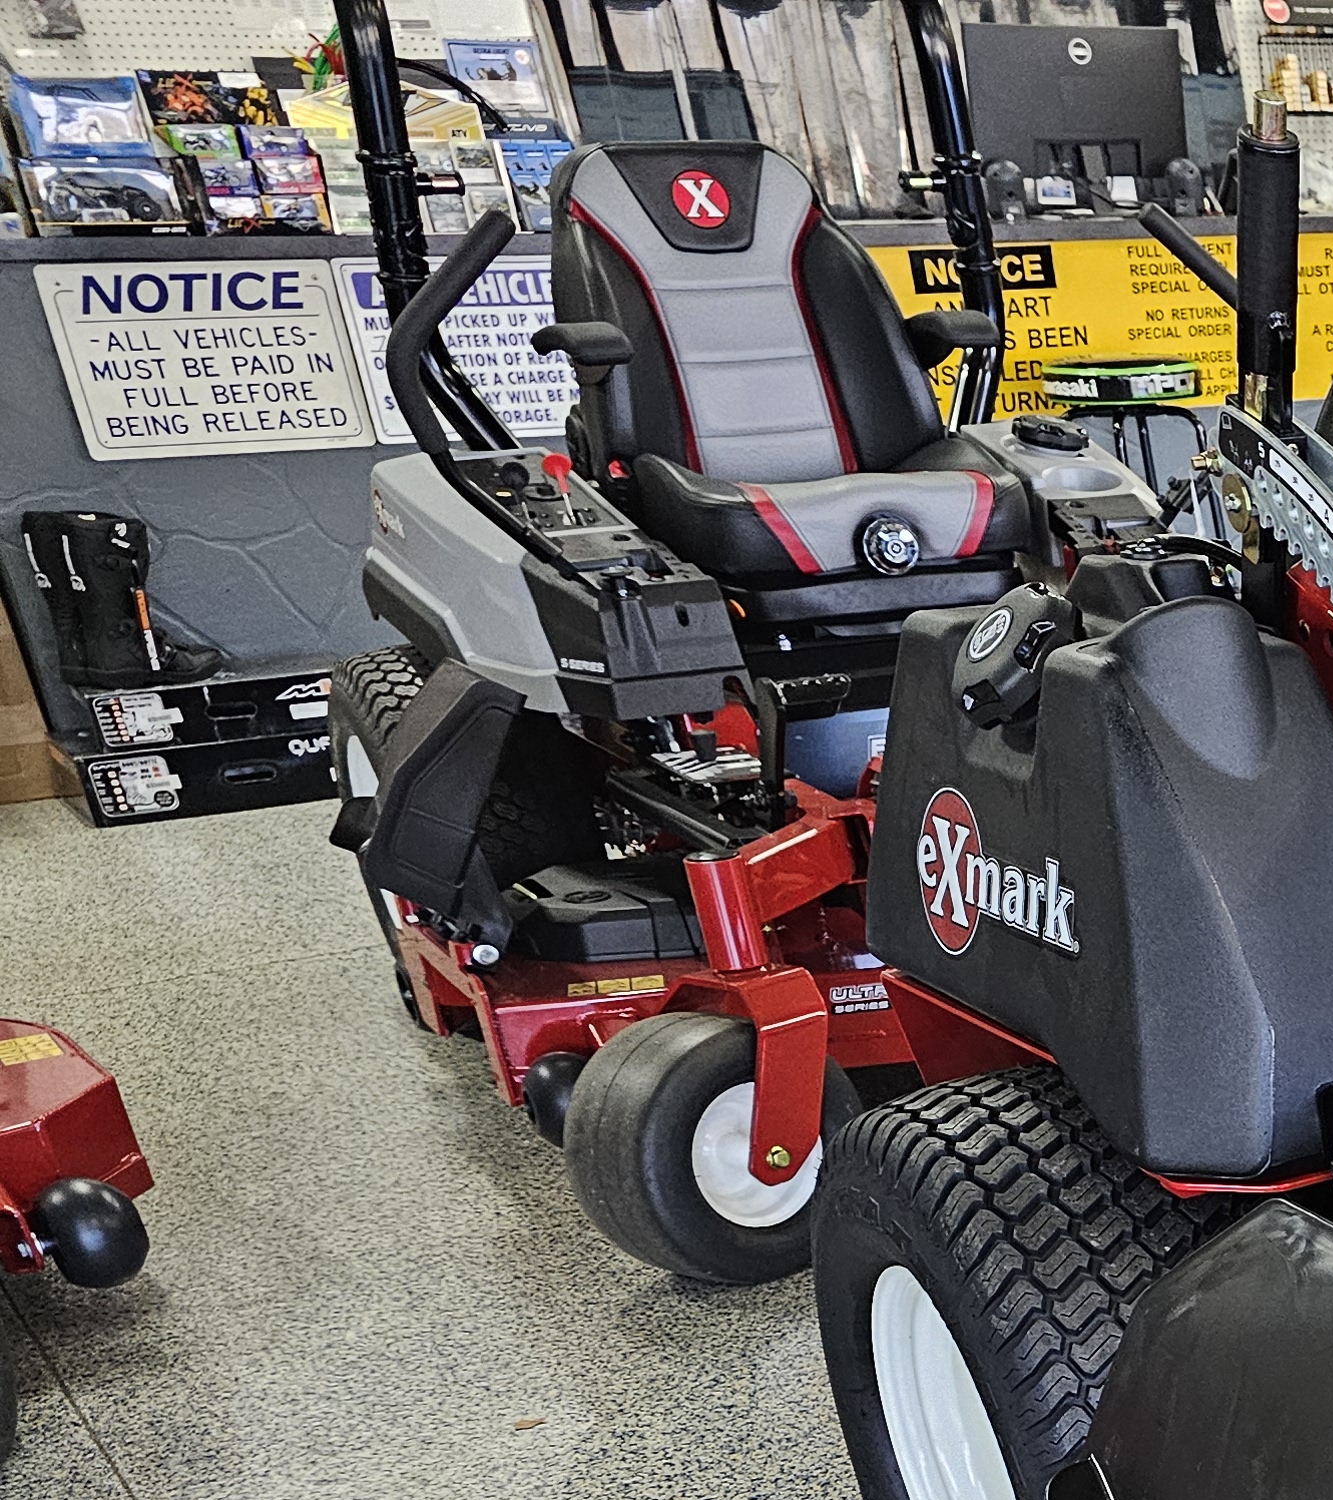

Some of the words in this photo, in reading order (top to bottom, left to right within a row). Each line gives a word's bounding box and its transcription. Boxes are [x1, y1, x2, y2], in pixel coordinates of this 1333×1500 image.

[677, 179, 725, 218] X
[1127, 245, 1162, 259] FULL
[924, 254, 1045, 287] NOCE
[1130, 262, 1191, 277] REQUIRE
[82, 271, 304, 315] NOTICE
[1131, 280, 1191, 295] SPECIAL
[1297, 283, 1311, 295] LL
[1006, 296, 1052, 318] ART
[1145, 309, 1165, 322] NO
[1172, 306, 1230, 320] RETURNS
[444, 313, 500, 330] PICKED
[508, 313, 529, 328] UP
[1312, 324, 1322, 336] A
[174, 326, 318, 350] VEHICLES-
[447, 332, 492, 348] AFTER
[1029, 326, 1089, 349] BEEN
[1128, 327, 1181, 341] SPECIAL
[1189, 323, 1232, 337] ORDER
[89, 358, 166, 382] MUST
[181, 356, 220, 378] BE
[231, 354, 295, 377] PAID
[306, 352, 335, 373] IN
[503, 352, 524, 367] OF
[507, 370, 567, 385] CHARGE
[122, 386, 199, 409] FULL
[211, 381, 318, 405] BEFORE
[508, 389, 544, 405] WILL
[548, 388, 566, 403] BE
[106, 414, 189, 438] BEING
[202, 407, 348, 434] RELEASED
[495, 407, 559, 424] TORAGE.
[917, 814, 1079, 953] eXmark
